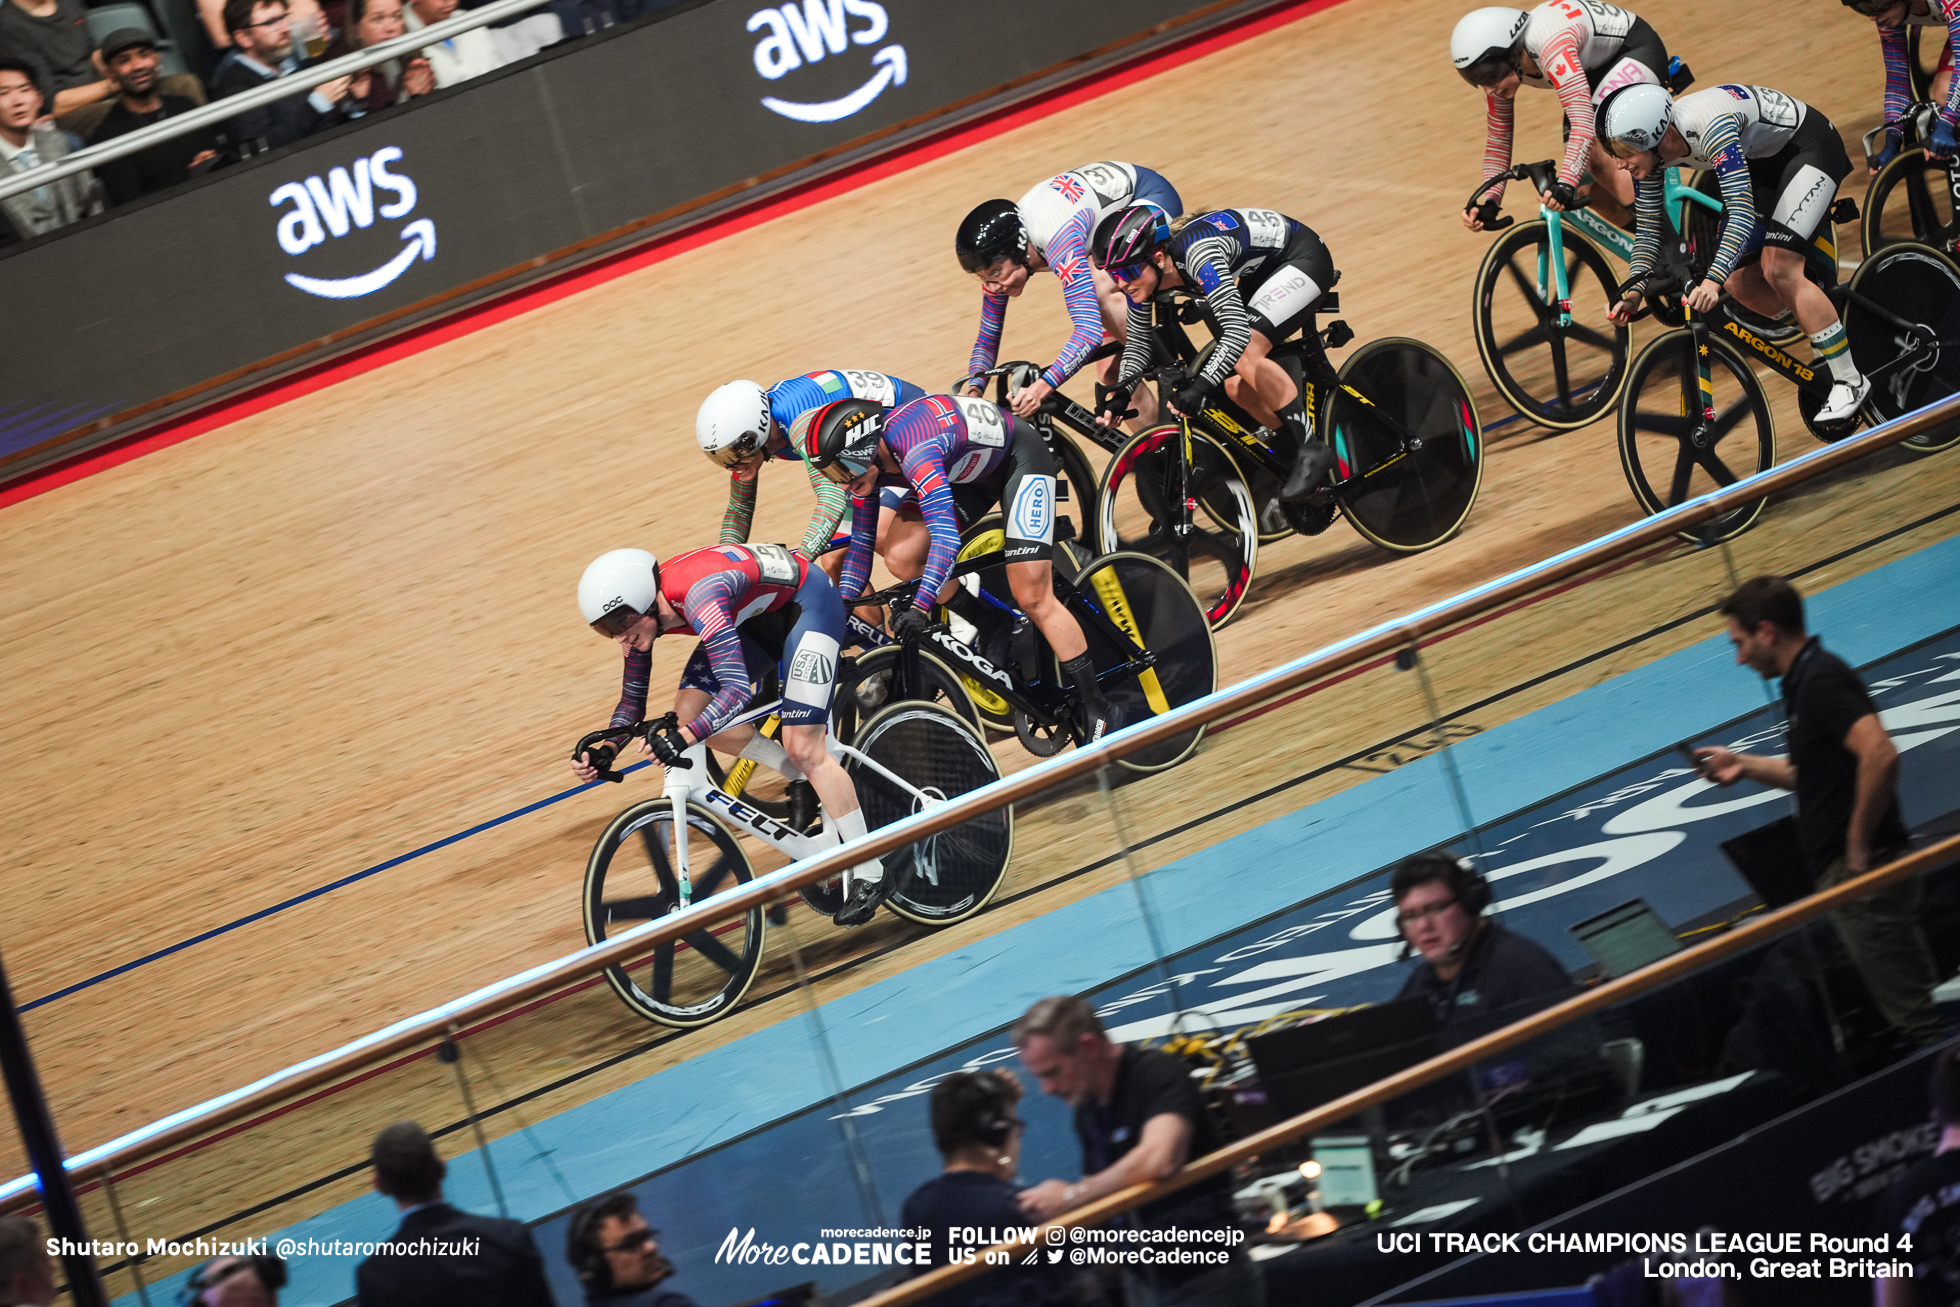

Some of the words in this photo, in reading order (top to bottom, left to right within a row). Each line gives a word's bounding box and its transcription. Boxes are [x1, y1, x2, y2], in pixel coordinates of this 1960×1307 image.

[745, 0, 890, 81] aws
[1083, 166, 1116, 187] 37
[269, 145, 418, 257] aws
[1248, 210, 1282, 228] 46
[1253, 276, 1307, 313] TREND
[1062, 340, 1092, 376] Santini
[1723, 321, 1792, 371] ARGON
[1793, 363, 1815, 382] 18
[852, 371, 885, 389] 39
[845, 413, 883, 448] HJC
[967, 403, 999, 427] 40
[1030, 488, 1044, 528] HERO
[806, 517, 833, 552] Santini
[756, 545, 785, 560] 47
[1004, 546, 1040, 558] antini
[602, 595, 624, 612] POC
[793, 653, 812, 678] USA
[803, 654, 817, 679] CYCLING
[931, 630, 1014, 691] KOGA
[711, 699, 745, 731] Santini
[782, 709, 813, 719] antini
[705, 789, 799, 841] FELT
